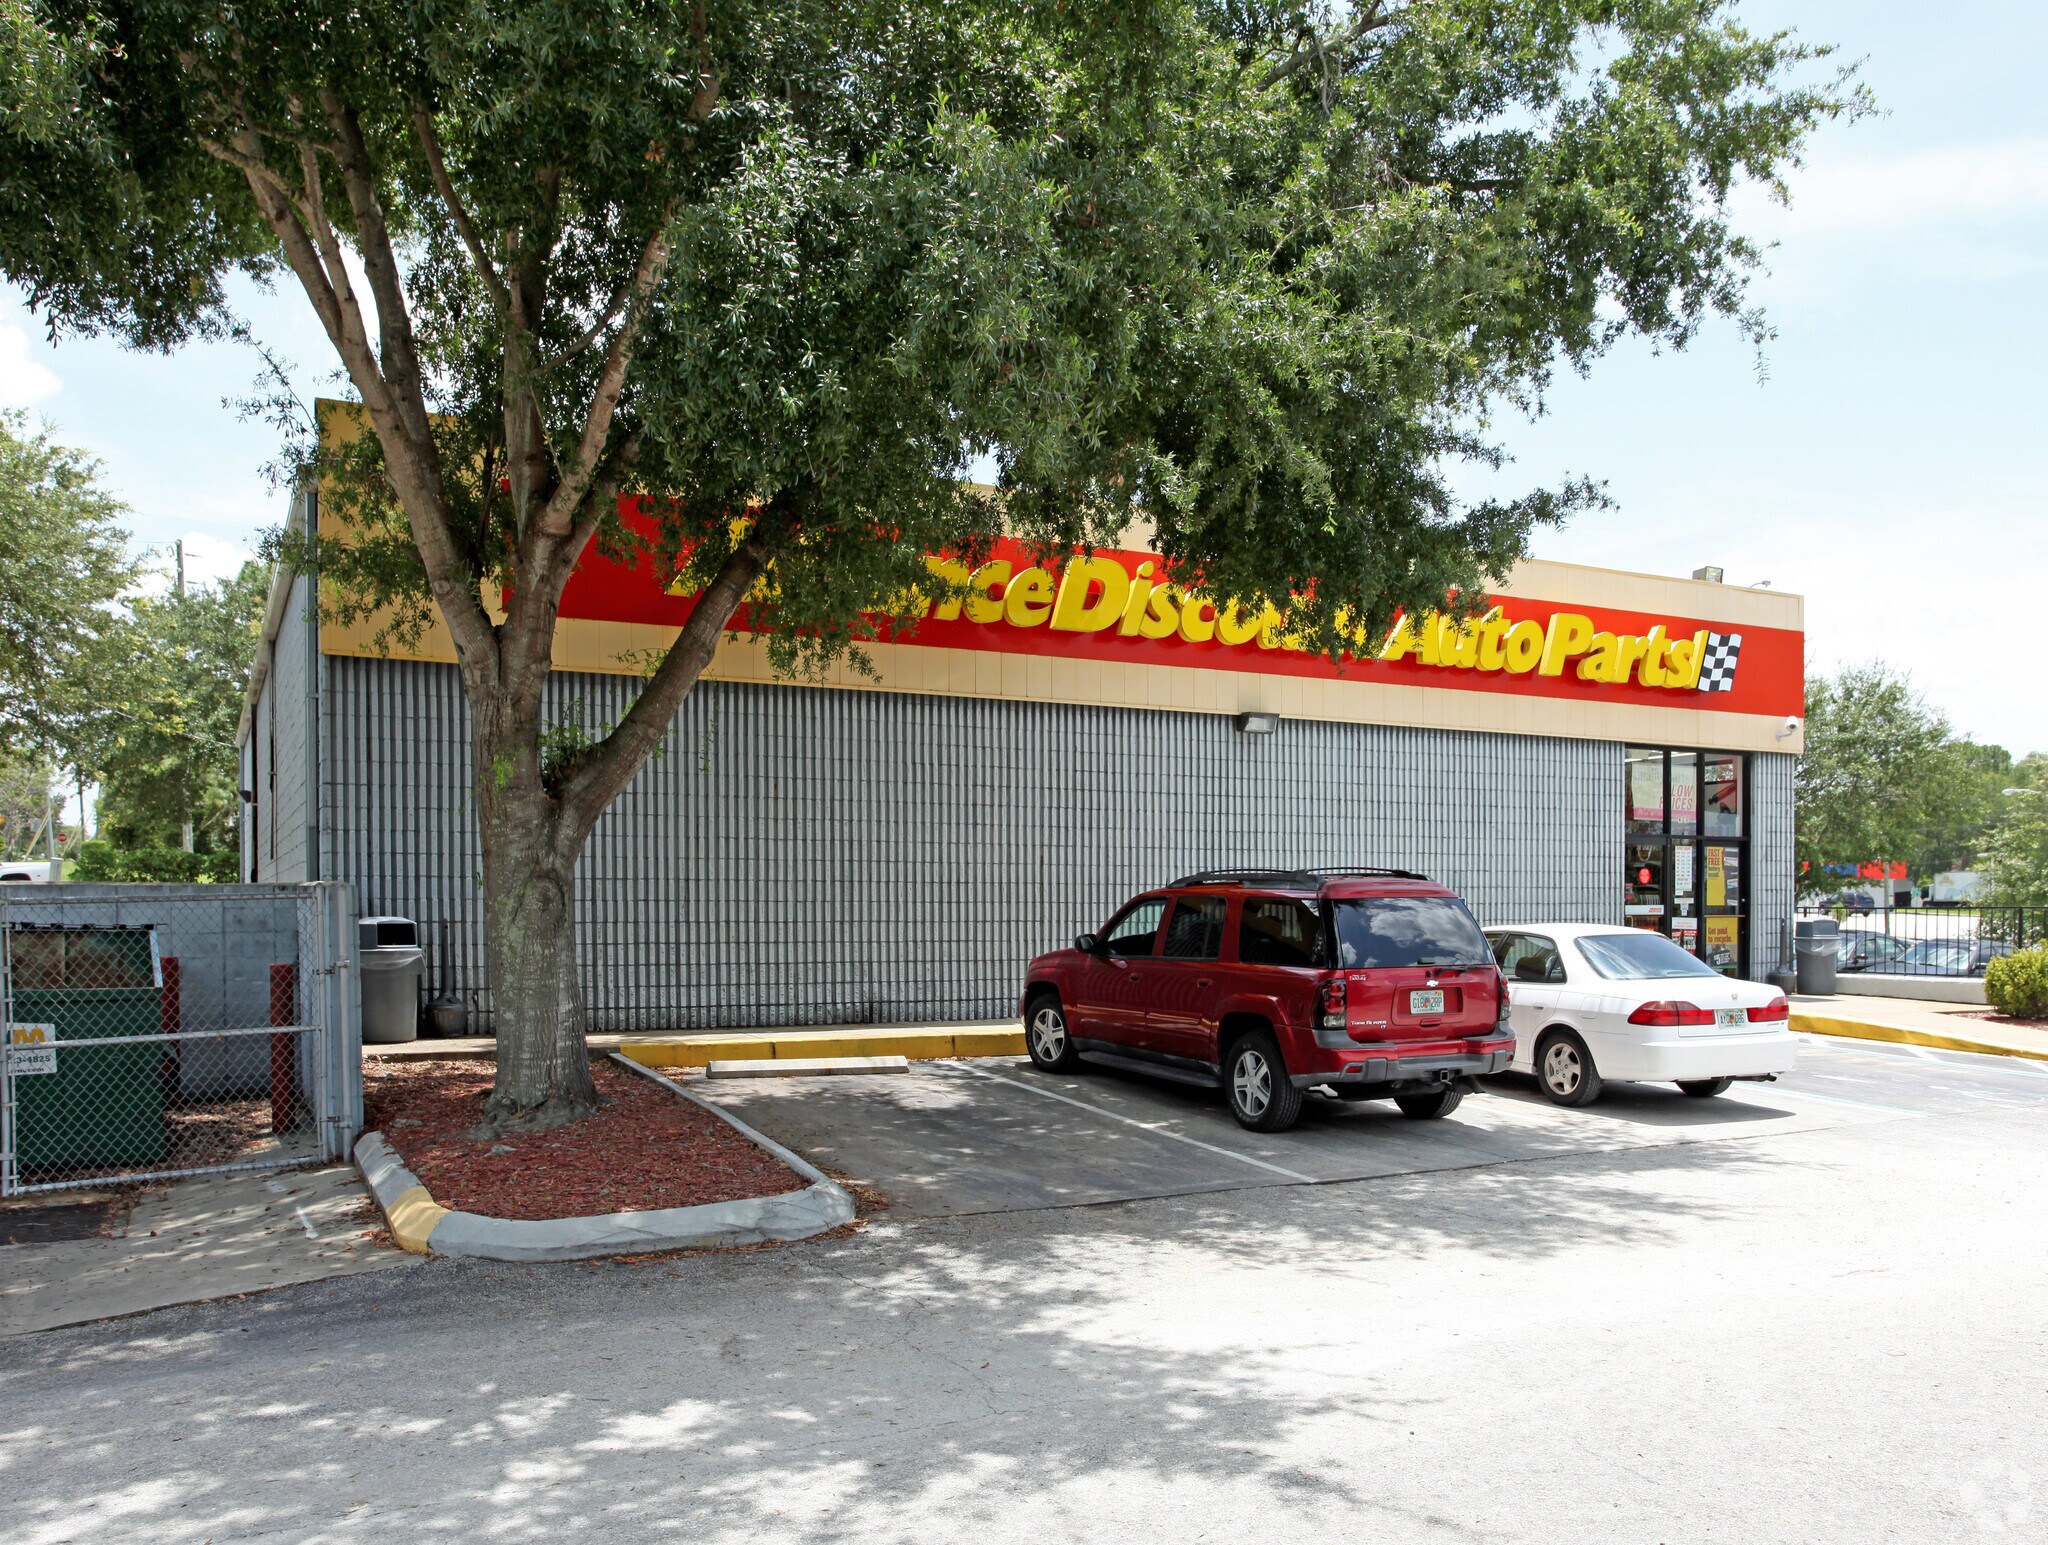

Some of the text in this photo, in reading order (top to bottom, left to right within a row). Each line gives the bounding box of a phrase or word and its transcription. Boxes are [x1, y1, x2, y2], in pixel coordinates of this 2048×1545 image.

[1672, 785, 1693, 797] LOW
[1659, 797, 1693, 810] PICES
[1708, 849, 1720, 857] FAST
[1708, 858, 1720, 866] FREE
[1708, 926, 1728, 935] Get paid
[14, 1055, 51, 1064] 3-4825
